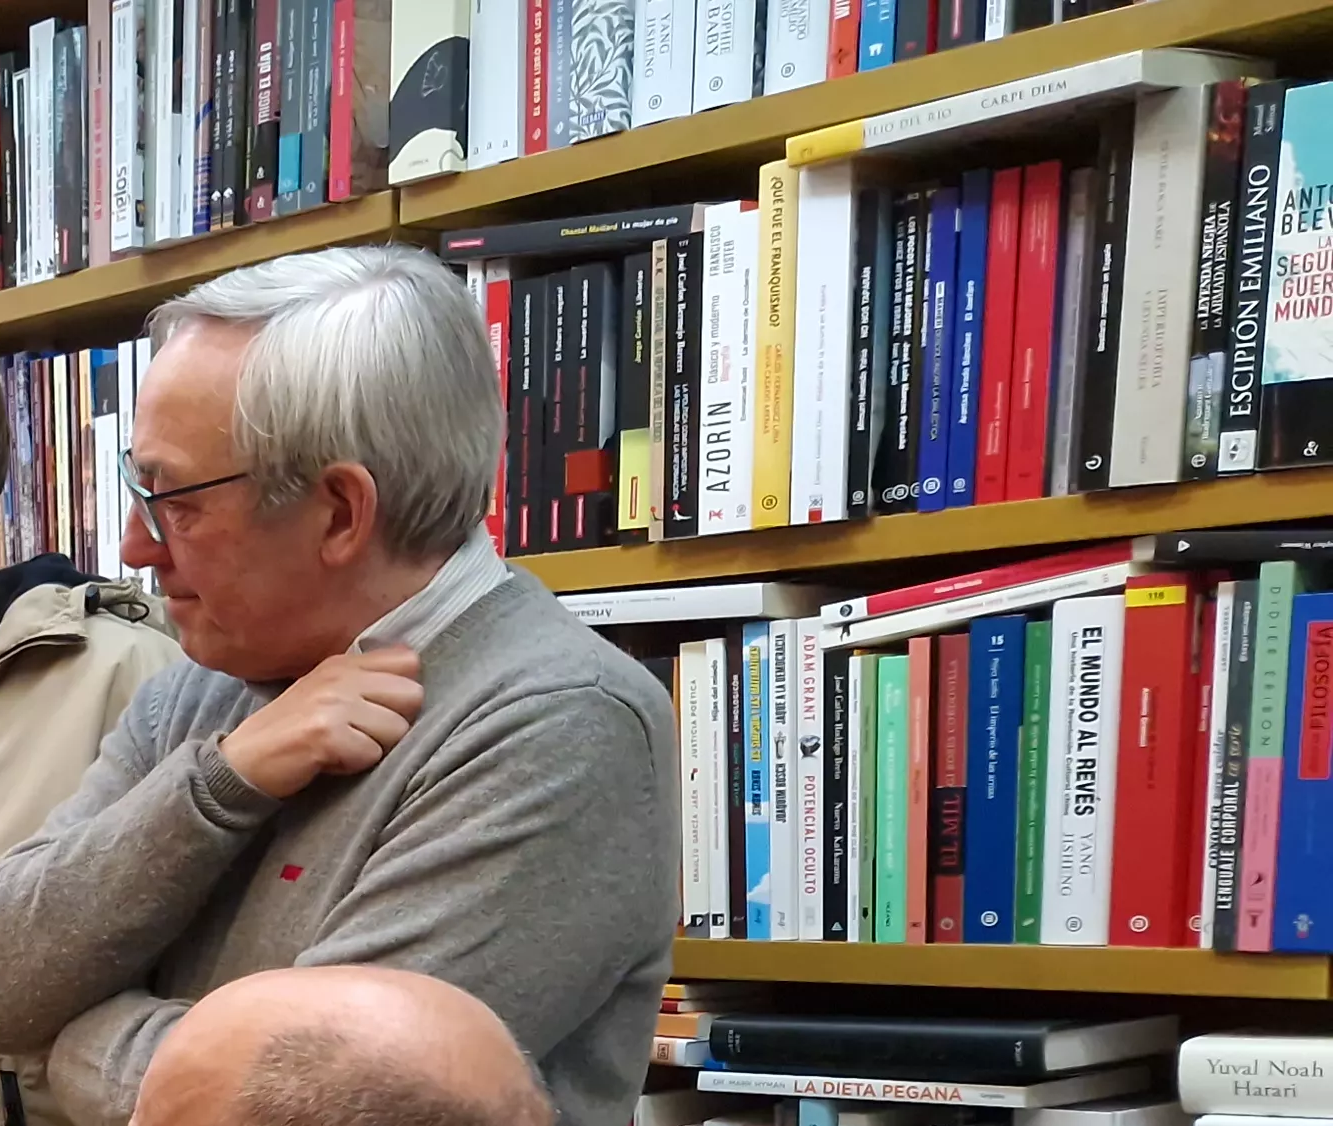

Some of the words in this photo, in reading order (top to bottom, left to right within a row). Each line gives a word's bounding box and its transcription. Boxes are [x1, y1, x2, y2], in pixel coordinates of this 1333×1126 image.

[660, 13, 671, 54] YANG
[706, 6, 721, 57] BABY
[719, 3, 733, 56] SOPHIE
[981, 90, 1024, 108] CARPE
[1031, 80, 1067, 98] DIEM
[111, 166, 131, 222] riglos
[771, 177, 785, 207] ¿QUÉ
[770, 208, 783, 230] FUE
[770, 231, 782, 244] EL
[1200, 215, 1216, 258] NEGRA
[1213, 201, 1230, 261] ESPAÑOLA
[1239, 164, 1271, 291] EMILIANO
[708, 224, 721, 276] FRANCISCO
[721, 239, 735, 274] FUSTER
[1276, 249, 1333, 277] SEGU
[1318, 235, 1332, 250] LA
[677, 273, 687, 302] Carlos
[768, 247, 782, 328] FRANQUISMO?
[1197, 261, 1213, 318] LEYENDA
[1210, 263, 1226, 315] ARMADA
[675, 303, 686, 340] Bermejo
[708, 295, 720, 338] moderno
[676, 341, 686, 374] Barrera
[708, 349, 720, 383] Clásico
[1229, 300, 1260, 417] ESCIPIÓN
[703, 401, 732, 493] AZORÍN
[990, 634, 1005, 646] 15
[1080, 626, 1103, 649] EL
[1266, 585, 1281, 656] DIDIER
[803, 635, 816, 672] ADAM
[688, 679, 698, 717] POÉTICA
[833, 675, 843, 694] José
[1077, 655, 1102, 723] MUNDO
[1309, 626, 1333, 731] FILOSOFÍA
[803, 677, 816, 722] GRANT
[833, 695, 843, 722] Carlos
[689, 720, 698, 758] JUSTICIA
[831, 724, 843, 756] Rodrigo
[986, 715, 999, 748] imperio
[1076, 729, 1097, 752] AL
[1074, 757, 1102, 817] REVÉS
[804, 776, 816, 843] POTENCIAL
[833, 802, 843, 831] Nuevo
[1221, 780, 1239, 844] CORPORAL
[804, 848, 816, 895] OCULTO
[833, 836, 844, 885] Kafkarama
[1060, 833, 1075, 897] JISHENG
[1079, 833, 1093, 876] YANG
[1217, 850, 1235, 909] LENGUAJE
[1206, 1058, 1258, 1077] Yuval
[1268, 1059, 1324, 1077] Noah
[793, 1080, 817, 1095] LA
[822, 1081, 877, 1098] DIETA
[882, 1083, 963, 1102] PEGANA
[1233, 1080, 1297, 1098] Harari
